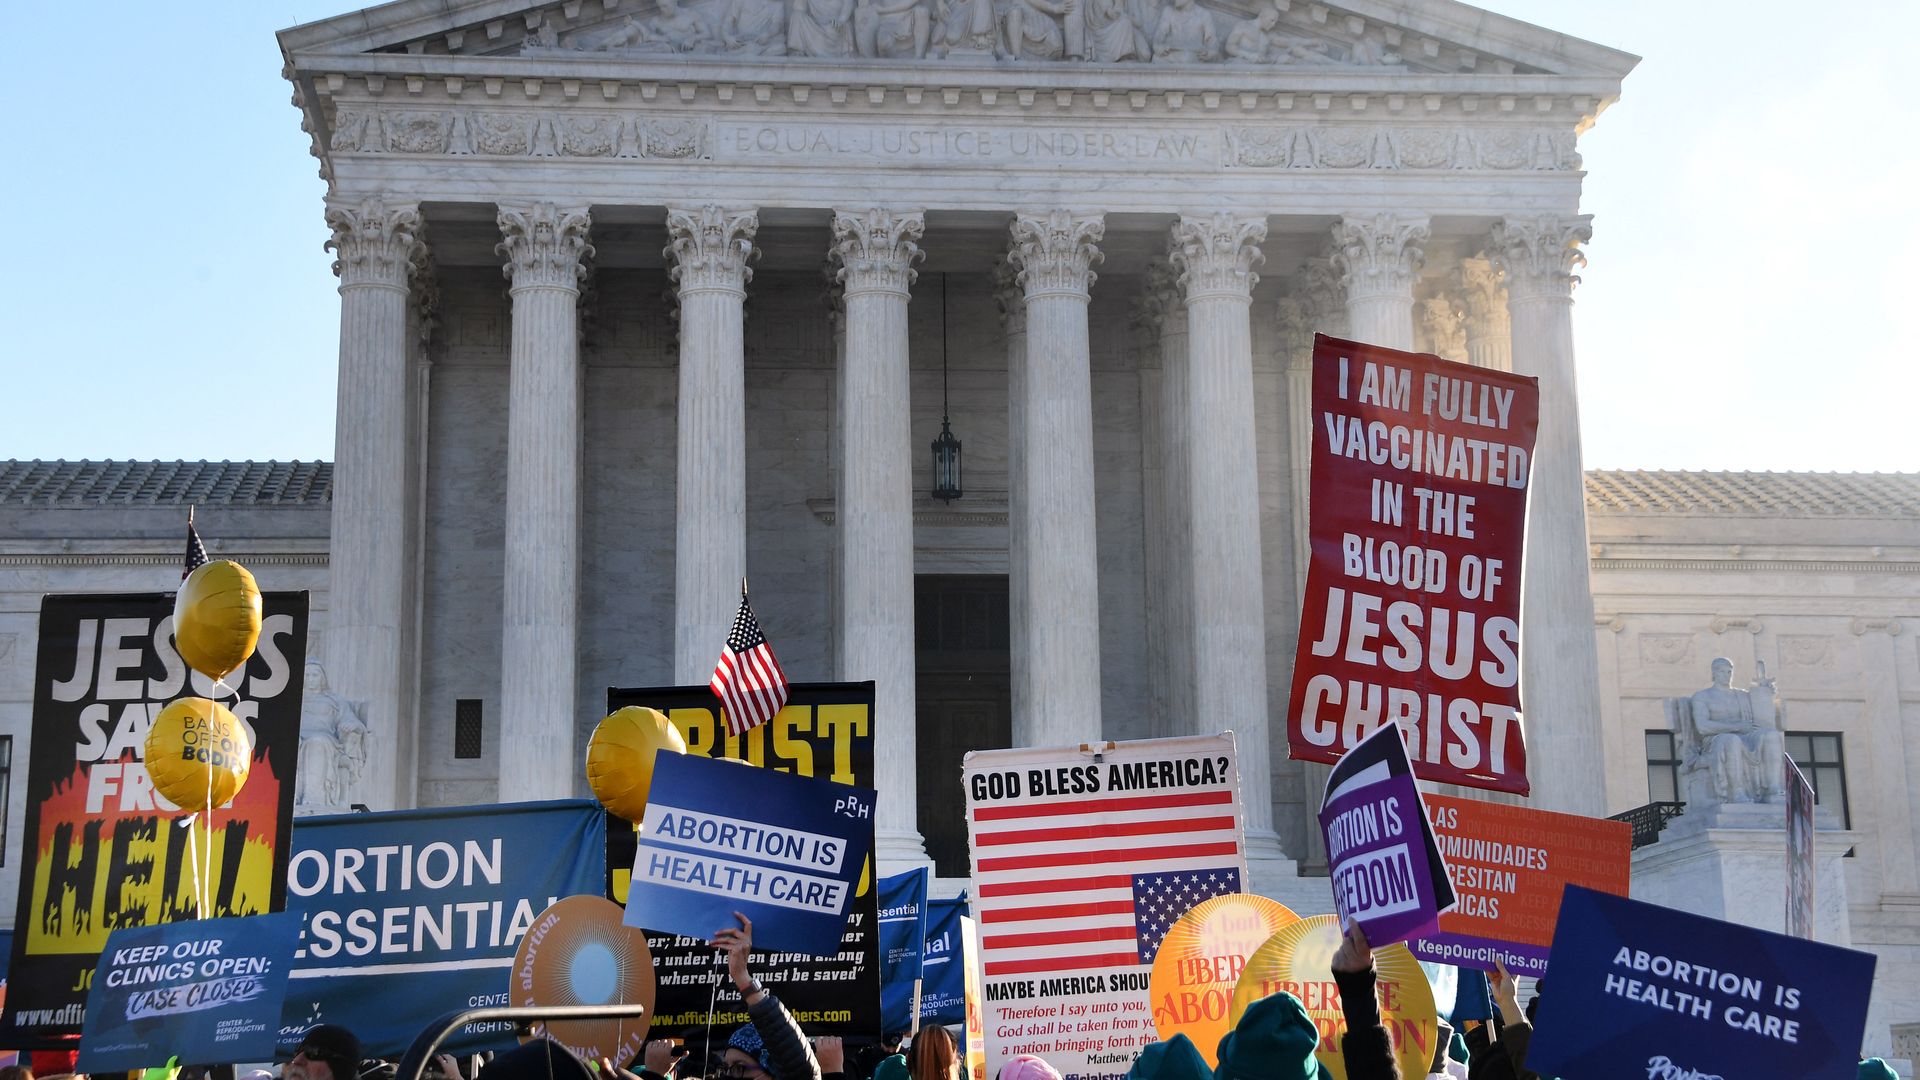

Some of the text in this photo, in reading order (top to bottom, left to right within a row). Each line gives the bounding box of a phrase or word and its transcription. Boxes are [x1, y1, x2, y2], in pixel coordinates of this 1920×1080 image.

[735, 127, 1200, 159] EQUAL JUSTICE UNDER LAW
[1338, 356, 1515, 430] I AM FULLY
[1324, 412, 1528, 490] VACCINATED
[1371, 478, 1475, 540] IN THE
[1342, 533, 1503, 602] BLOOD OF
[1311, 587, 1519, 689] JESUS
[75, 700, 259, 762] SAS
[184, 716, 231, 737] BANS
[1300, 674, 1518, 775] CHRIST
[182, 730, 244, 756] OFF OU
[650, 703, 868, 785] RUST
[85, 763, 233, 814] FR
[971, 756, 1229, 801] GOD BLESS AMERICA?
[834, 795, 869, 819] PRH
[1380, 796, 1403, 838] IS
[655, 812, 810, 861] ABORTION
[811, 839, 838, 866] IS
[43, 816, 258, 937] HELL
[648, 853, 763, 896] HEALTH
[769, 875, 840, 908] CARE
[294, 896, 558, 958] SSENTIA
[111, 939, 223, 966] KEEP OUR
[520, 912, 560, 990] abortion.
[665, 952, 709, 967] under
[713, 950, 765, 965] heen
[769, 951, 811, 966] given
[106, 957, 272, 987] CLINICS OPEN:
[660, 970, 724, 987] whereby
[752, 969, 789, 983] must
[791, 968, 810, 982] be
[986, 980, 1035, 1001] MAYBE
[1039, 975, 1106, 997] AMERICA
[1613, 946, 1801, 1010] ABORTION IS
[131, 979, 256, 1015] CASE CLOSED
[716, 989, 742, 1001] Acts
[909, 993, 937, 1004] CNTER
[909, 997, 965, 1011] RPRODUCTIVE
[1060, 1003, 1065, 1015] I
[1068, 1004, 1088, 1017] say
[1091, 1001, 1118, 1014] unto
[1122, 1001, 1147, 1013] you,
[1262, 980, 1400, 1012] LIBERE
[1604, 973, 1800, 1044] HEALTH CARE
[216, 1023, 266, 1035] REPRODUCTIVE
[217, 1018, 243, 1028] CENTER
[910, 1009, 938, 1019] RGHTS
[997, 1024, 1023, 1038] God
[1027, 1022, 1055, 1036] shall
[1058, 1021, 1073, 1034] be
[1076, 1018, 1109, 1032] taken
[1111, 1017, 1142, 1029] from
[214, 1033, 239, 1042] RIGHTS
[1001, 1045, 1008, 1055] a
[1012, 1042, 1050, 1055] nation
[1054, 1037, 1104, 1053] bringing
[1107, 1035, 1135, 1048] forth
[1087, 1051, 1142, 1065] Matthew 2
